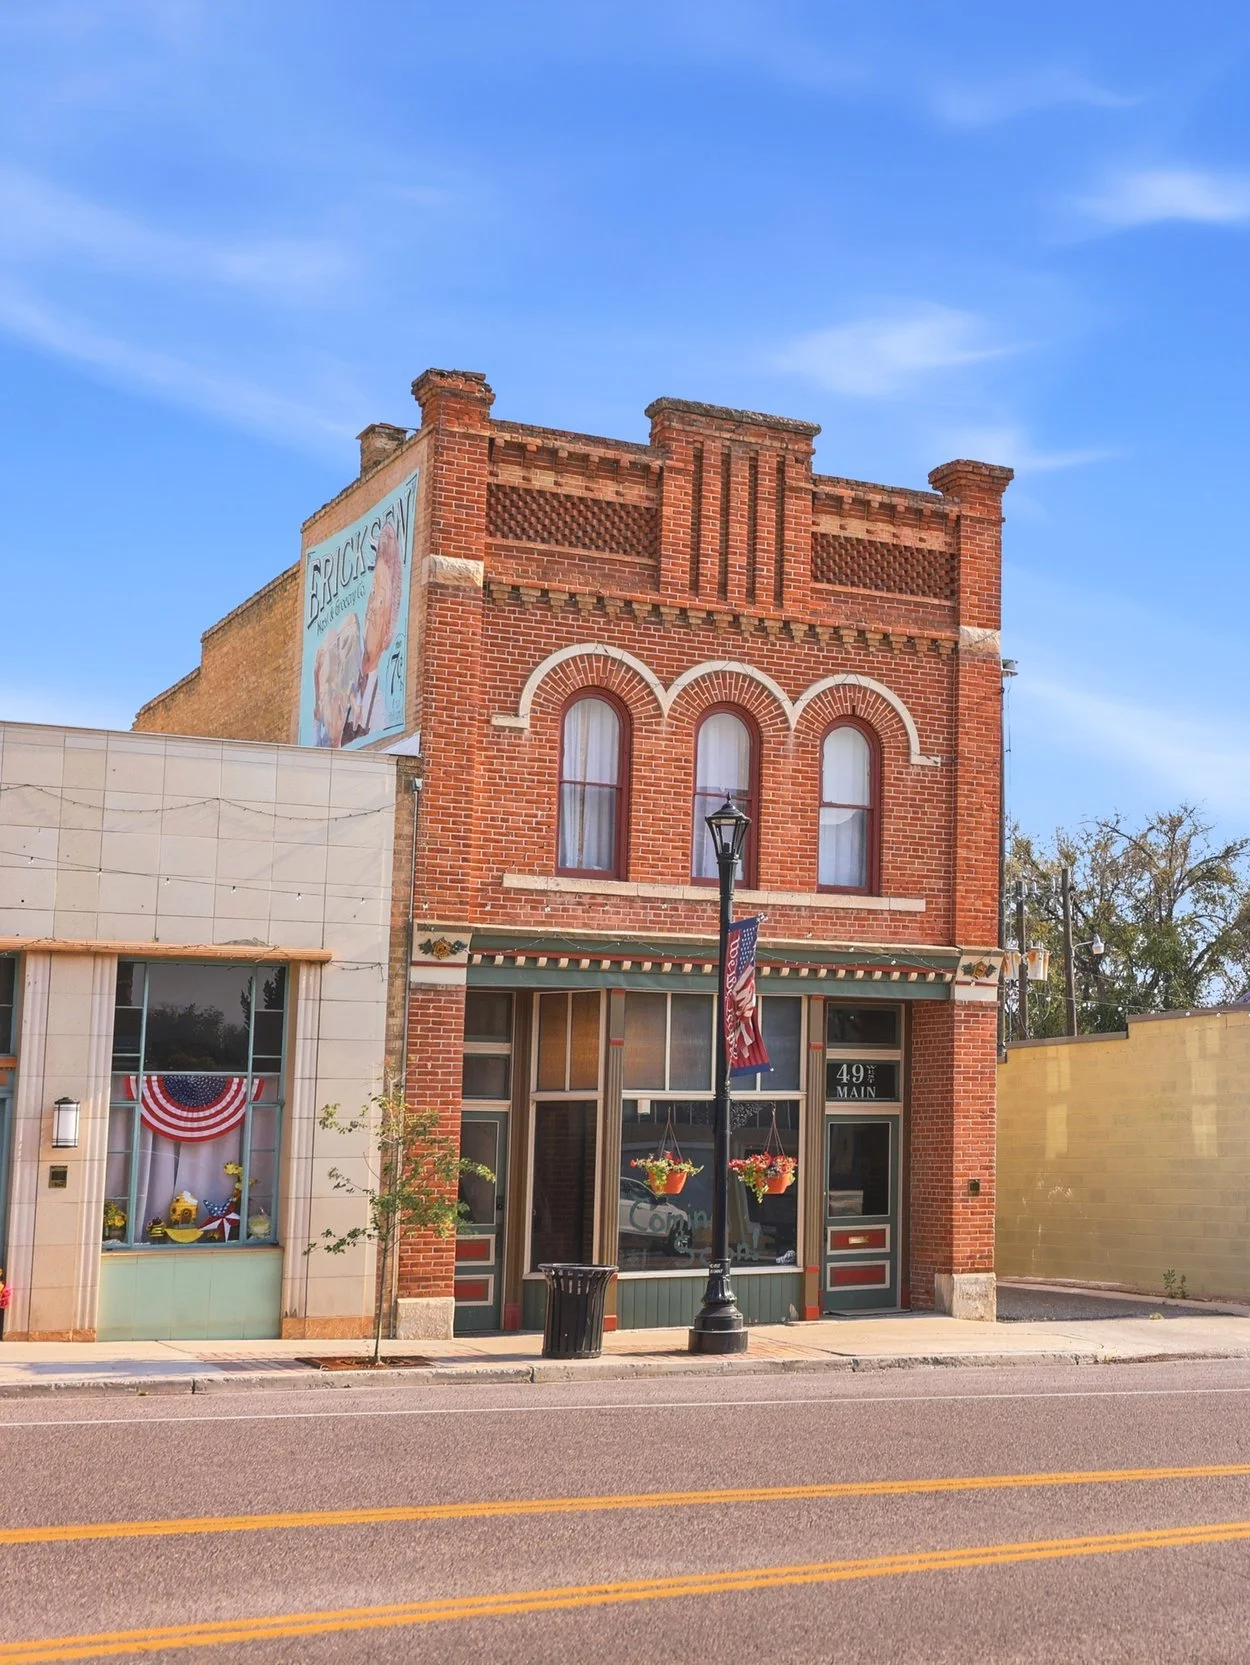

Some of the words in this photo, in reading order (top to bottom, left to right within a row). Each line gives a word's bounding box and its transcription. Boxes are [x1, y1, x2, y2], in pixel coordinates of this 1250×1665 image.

[728, 936, 740, 970] We
[836, 1063, 865, 1084] 49
[836, 1086, 876, 1098] MAIN
[629, 1195, 710, 1236] Comin
